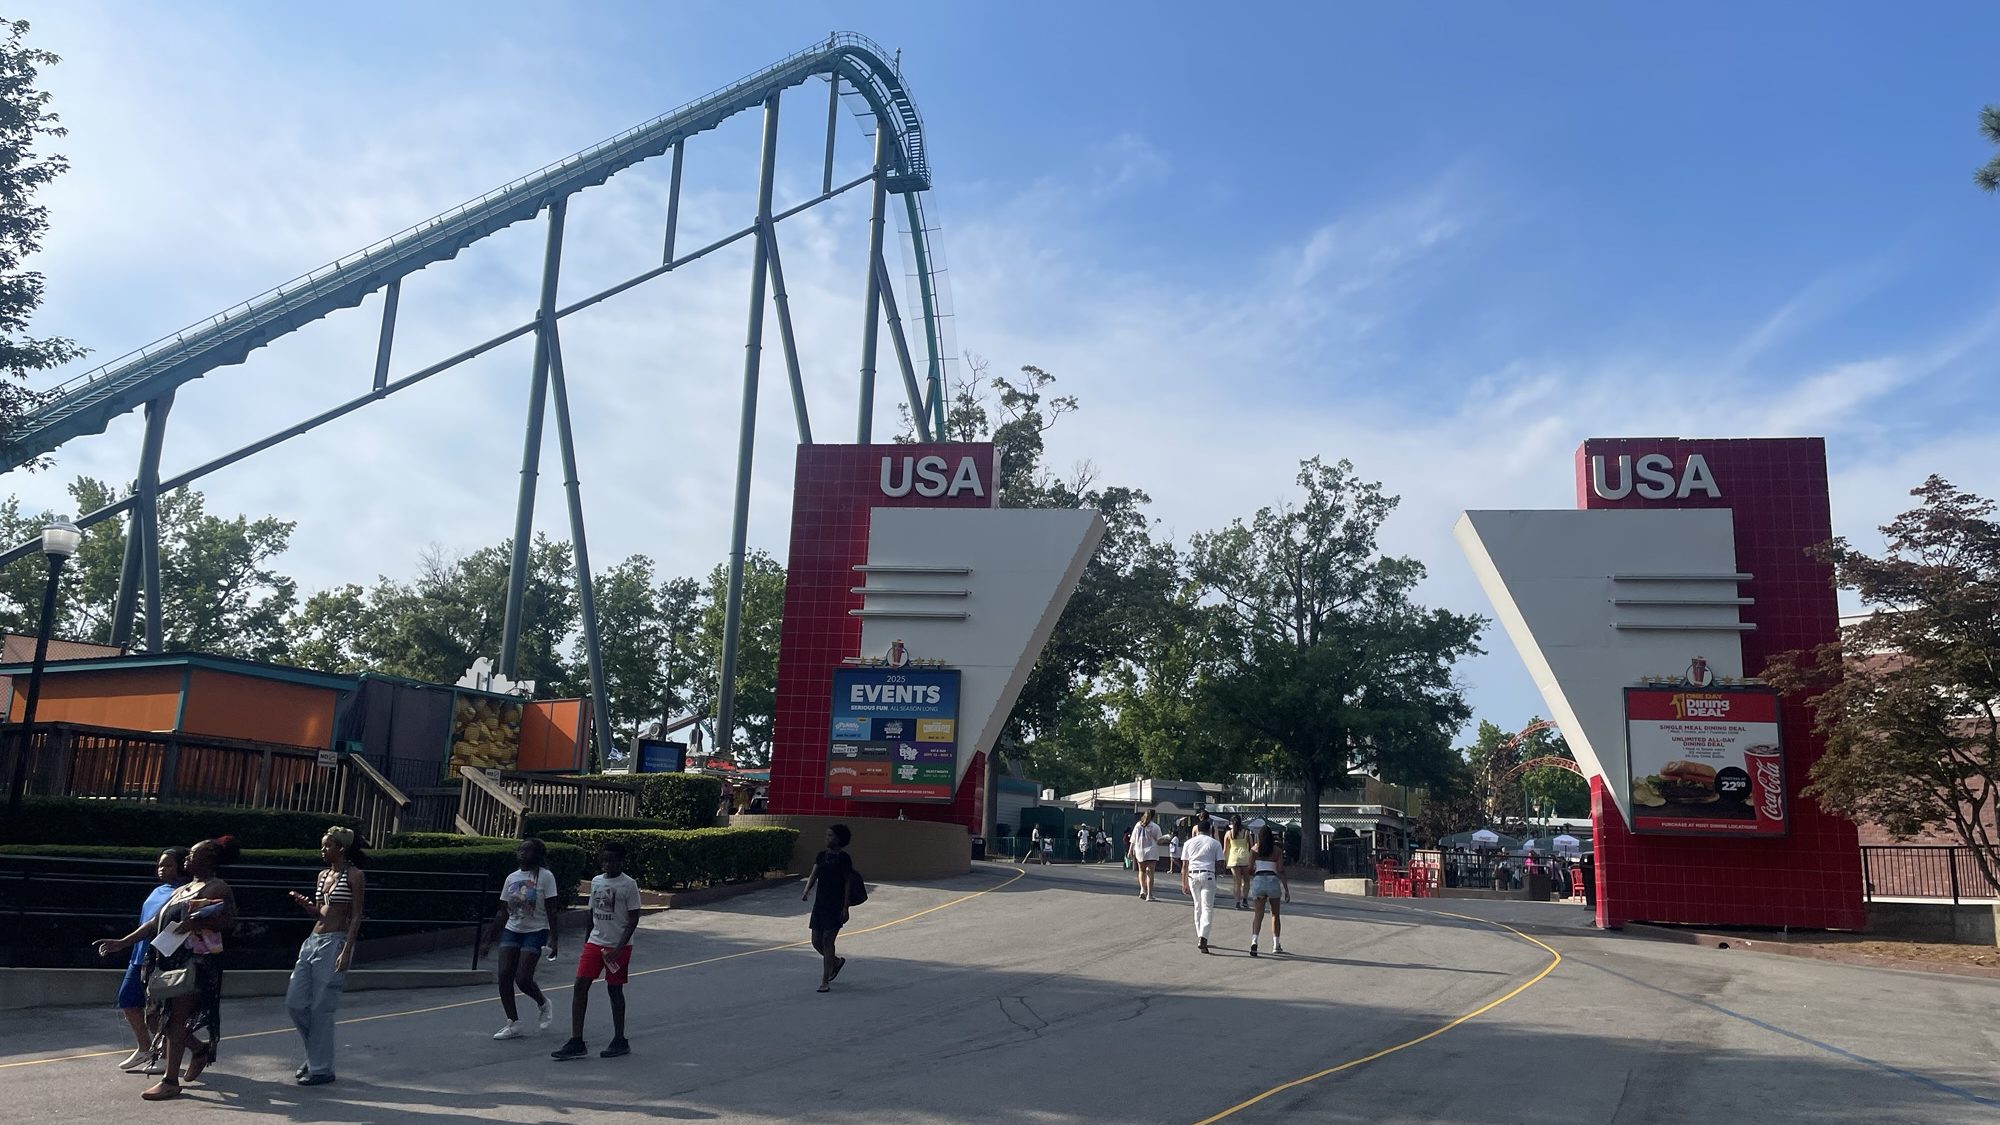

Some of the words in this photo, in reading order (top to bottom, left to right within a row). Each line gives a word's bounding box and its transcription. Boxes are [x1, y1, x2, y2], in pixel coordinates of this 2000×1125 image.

[880, 455, 985, 498] USA
[1592, 453, 1722, 500] USA
[886, 675, 906, 683] 2025
[850, 684, 941, 704] EVENTS
[1686, 699, 1730, 711] Dining
[1687, 708, 1726, 717] DEAL
[1756, 758, 1783, 821] Coca-Cola
